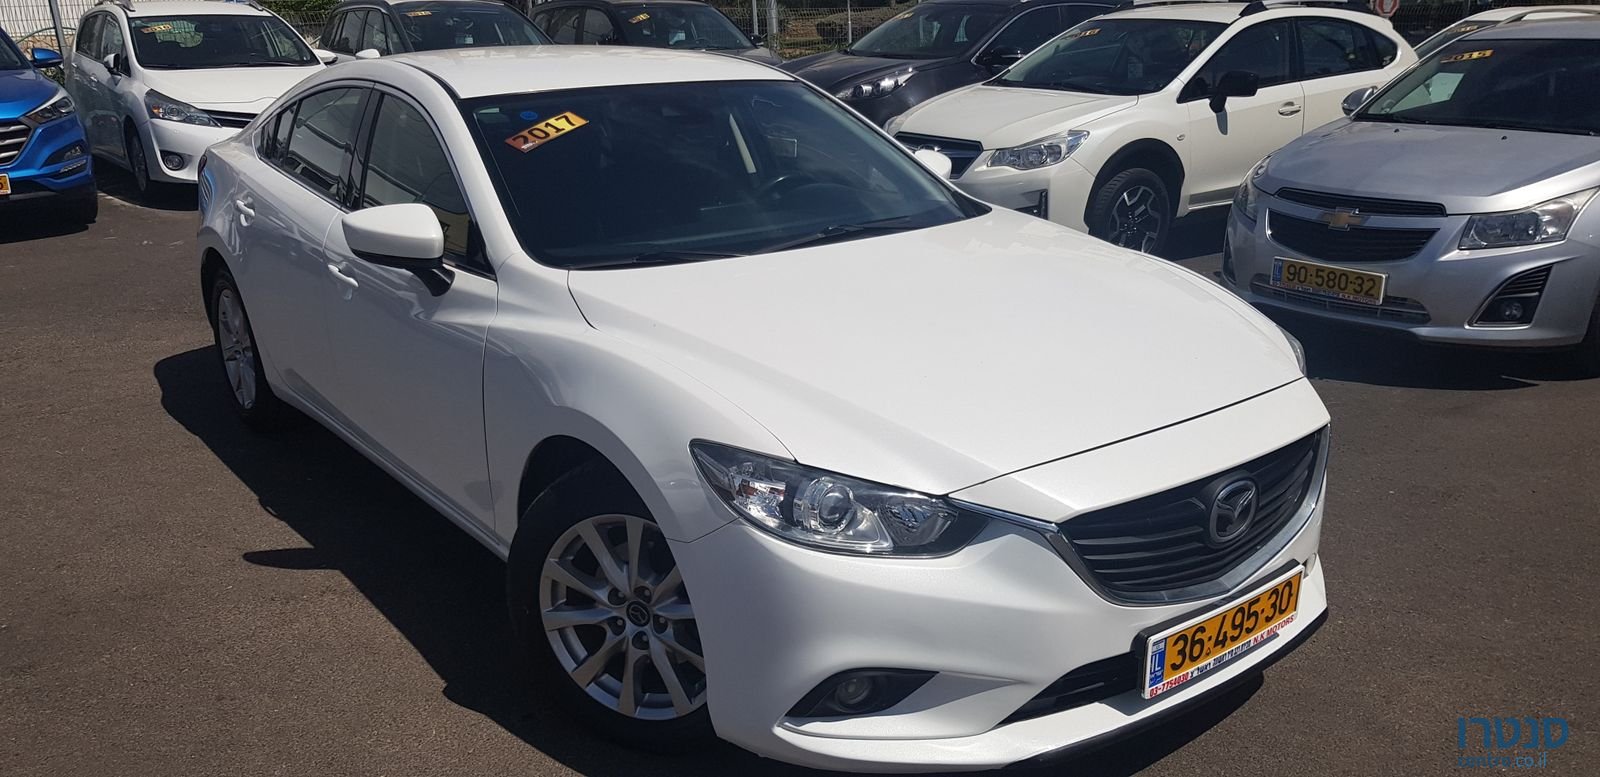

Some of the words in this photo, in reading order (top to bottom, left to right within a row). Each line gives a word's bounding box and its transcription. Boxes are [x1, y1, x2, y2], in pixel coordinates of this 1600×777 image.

[512, 115, 576, 146] 2017
[1266, 615, 1294, 636] MOTORS
[1151, 654, 1162, 673] IL
